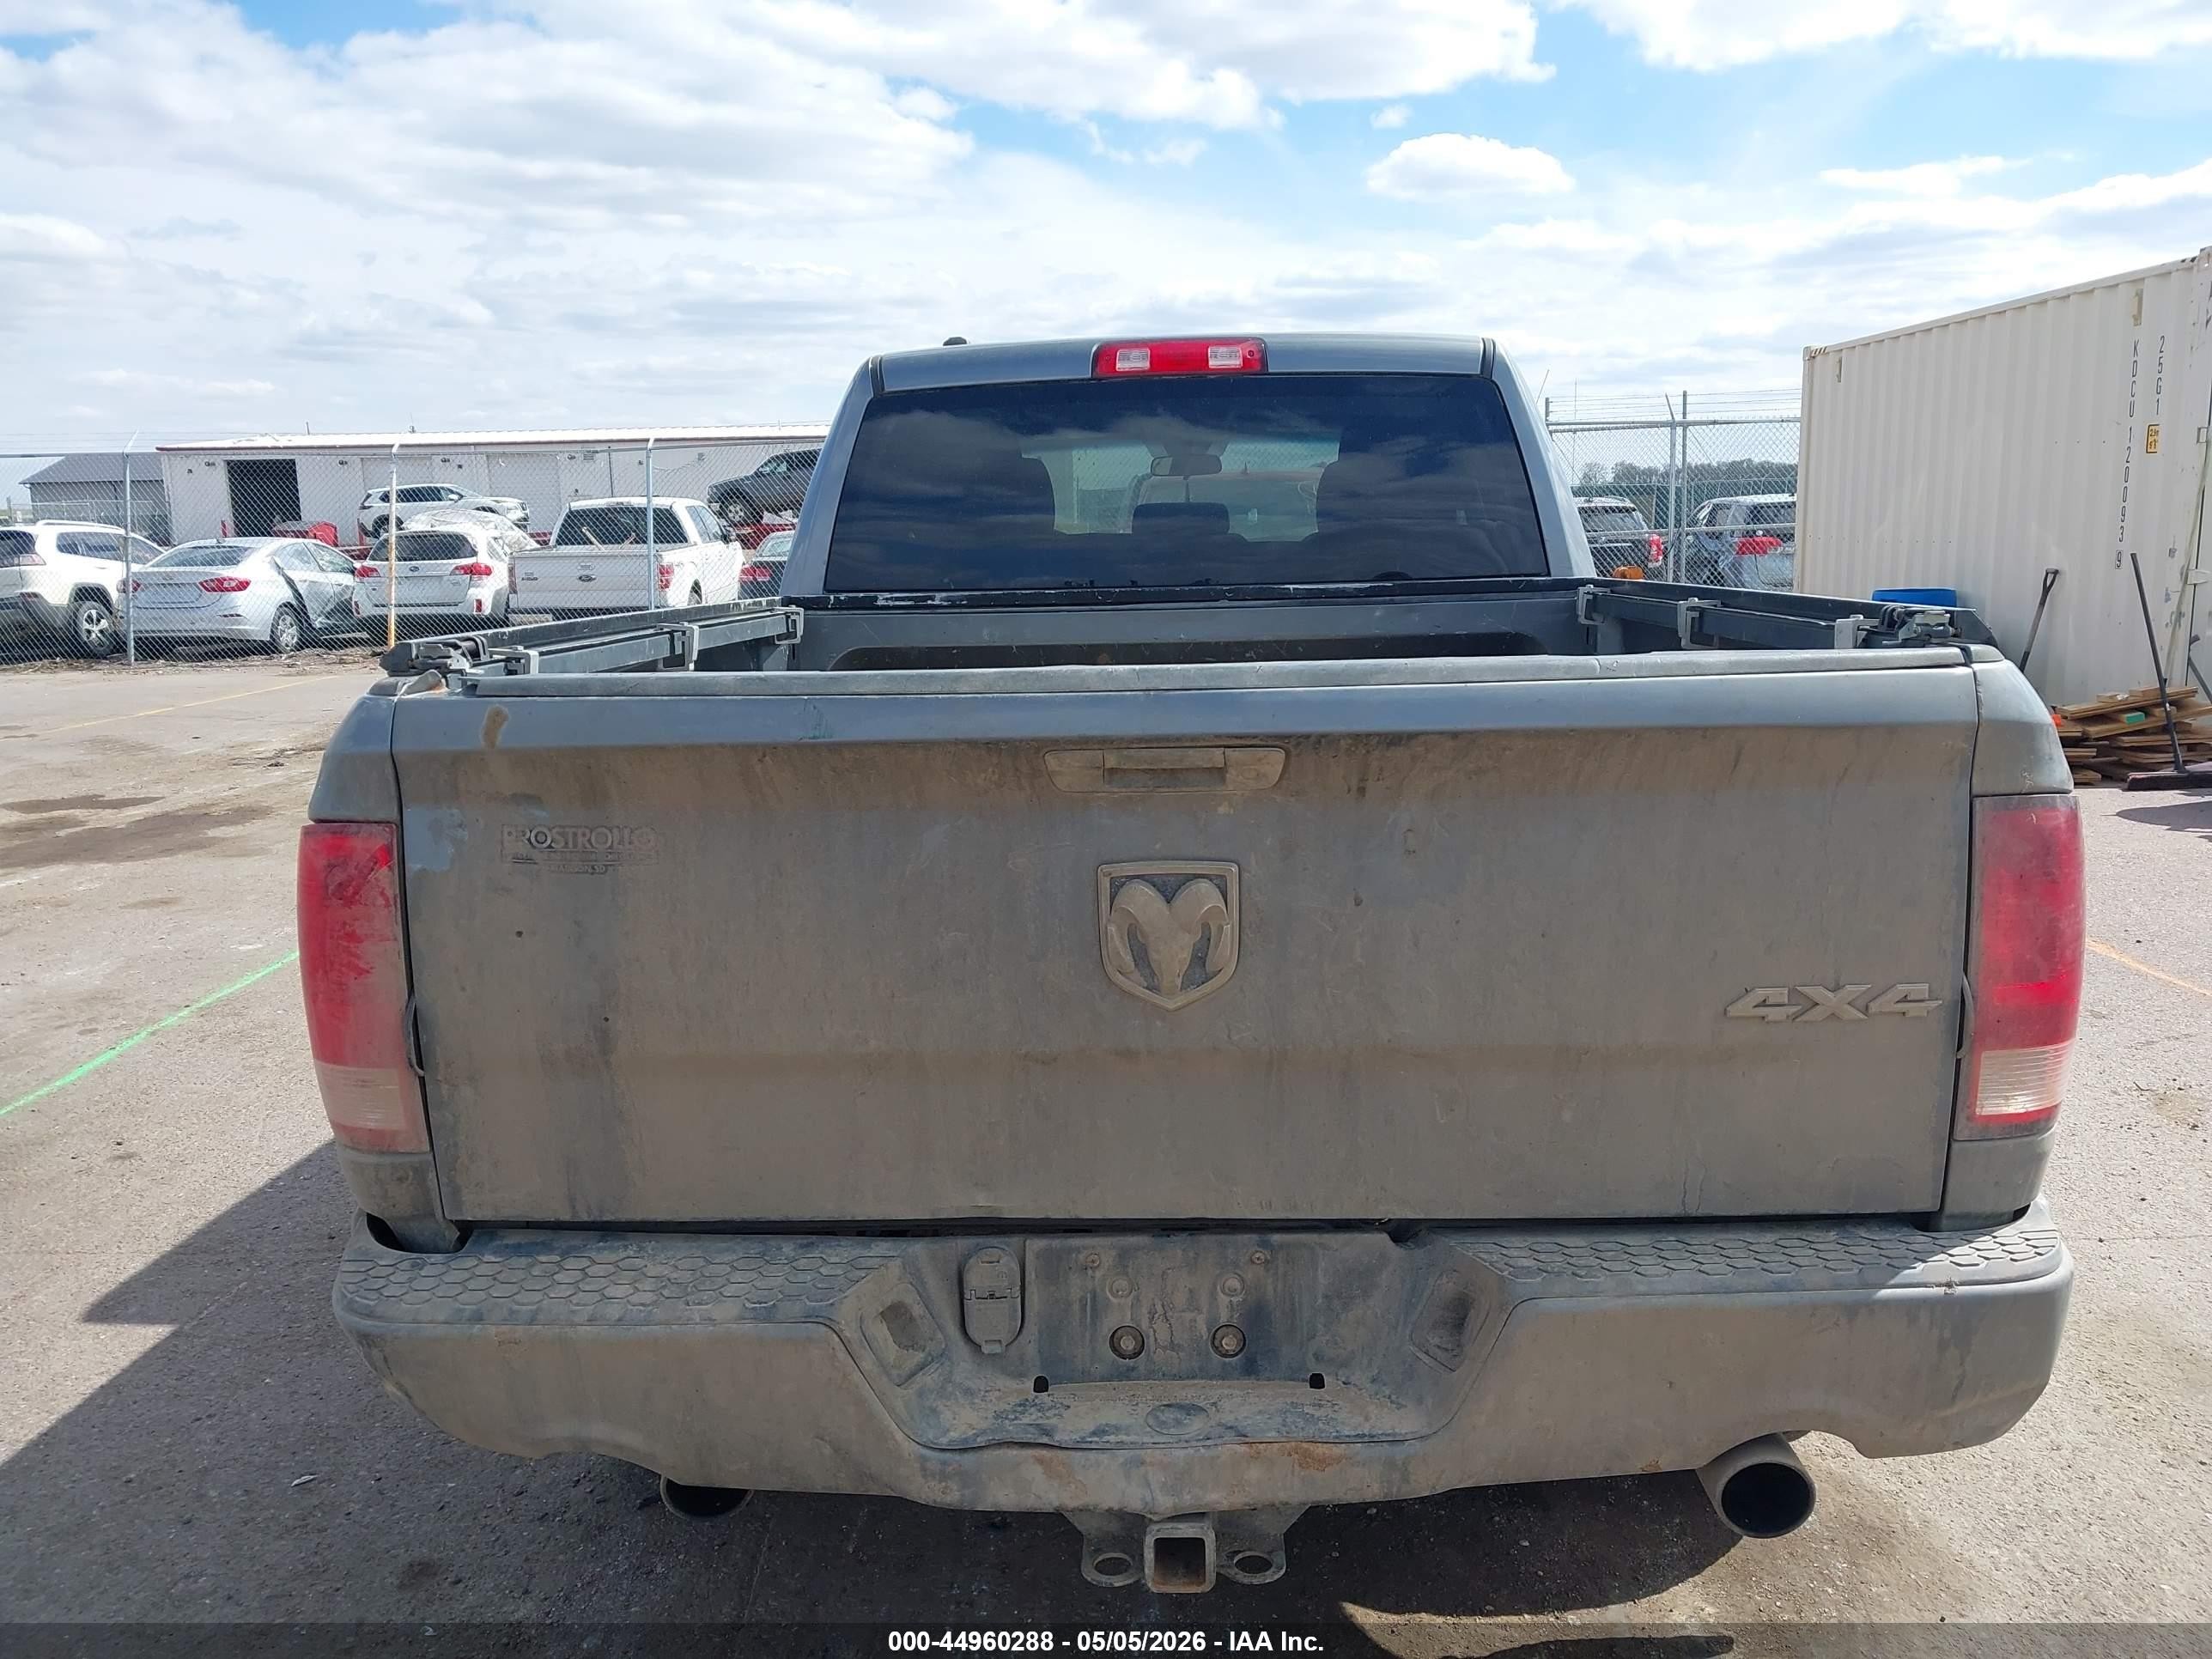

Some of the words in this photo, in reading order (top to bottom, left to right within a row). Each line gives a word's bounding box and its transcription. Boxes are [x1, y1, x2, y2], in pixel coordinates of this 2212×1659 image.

[2129, 338, 2139, 418] KDCU
[2155, 335, 2165, 416] 25G1
[2118, 425, 2133, 543] 120093
[2116, 550, 2123, 568] 9
